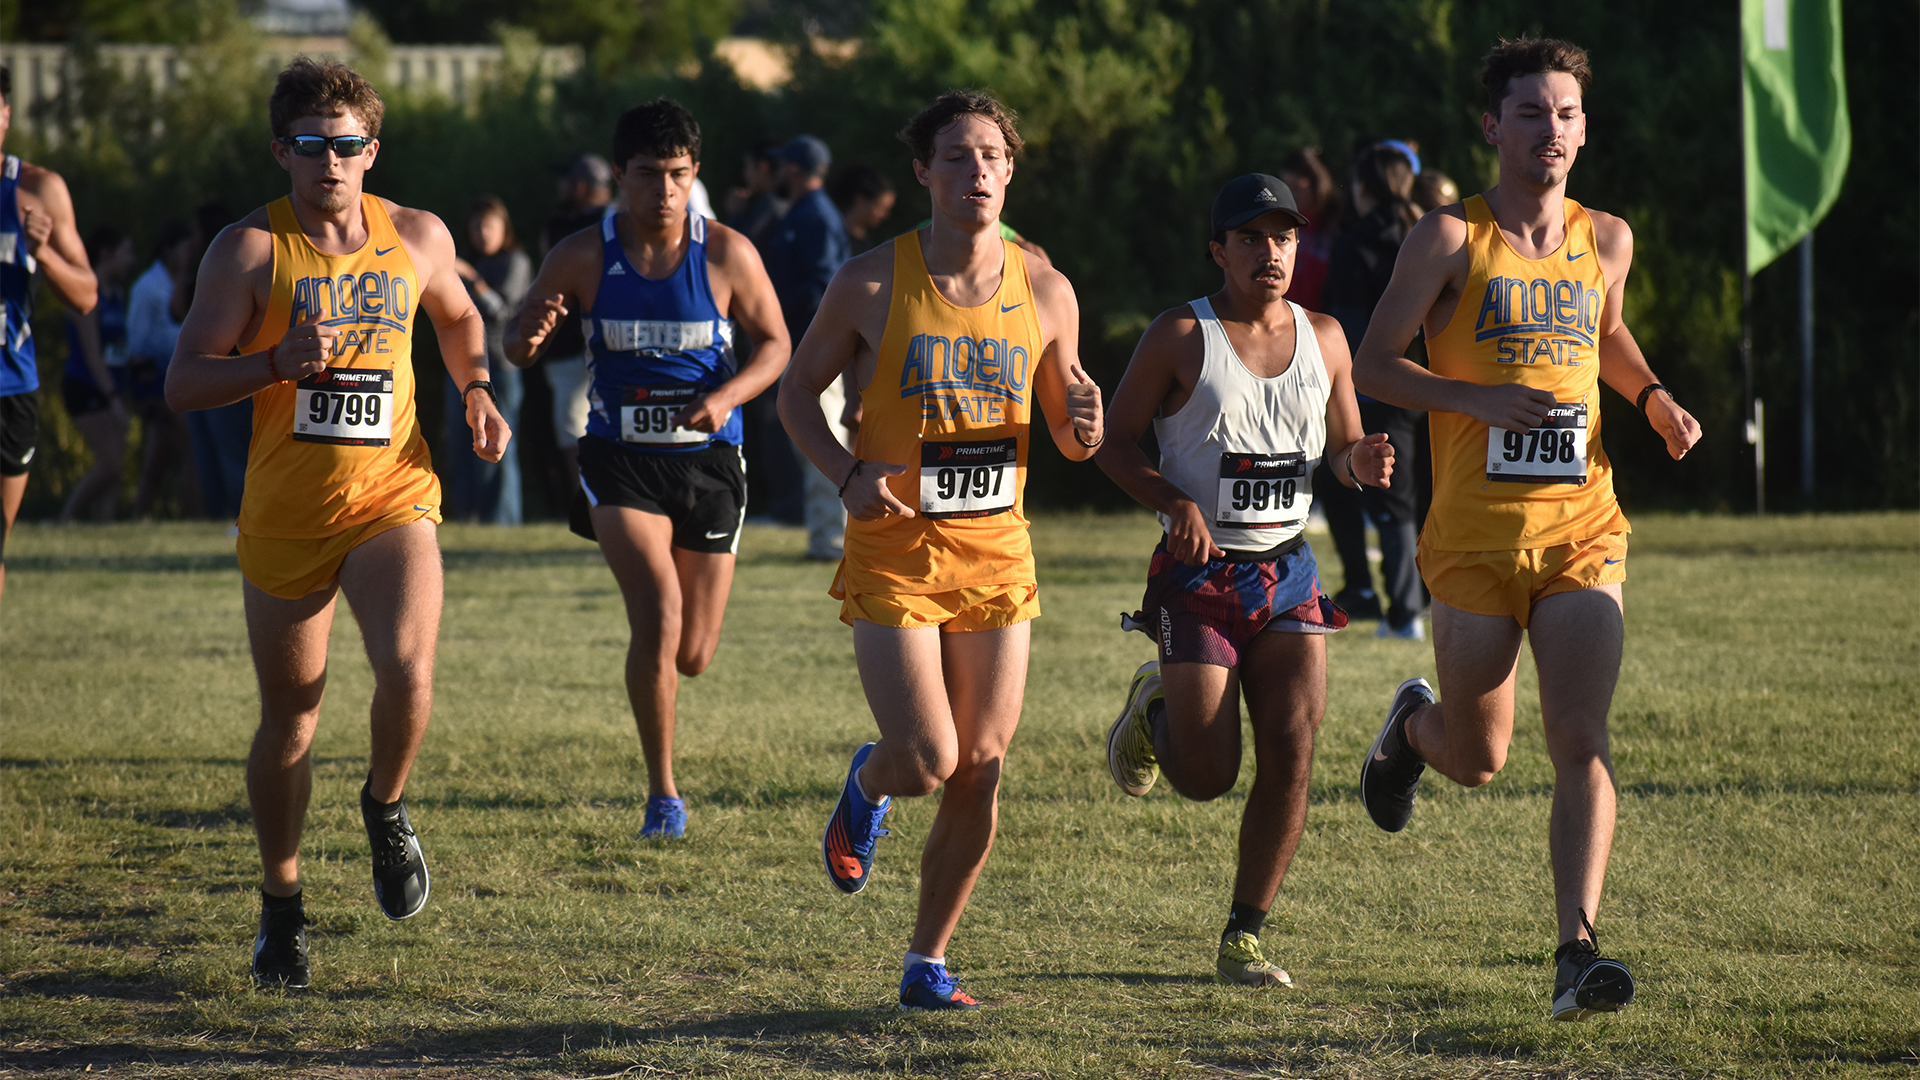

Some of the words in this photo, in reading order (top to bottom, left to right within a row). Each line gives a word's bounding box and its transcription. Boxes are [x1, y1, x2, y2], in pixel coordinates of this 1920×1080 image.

[289, 270, 410, 329] Angelo
[1475, 275, 1600, 334] Angelo
[332, 328, 391, 356] TATE
[601, 319, 715, 351] WESTERN
[900, 333, 1028, 391] Angelo
[1497, 337, 1582, 366] STATE
[332, 373, 382, 382] PRIMETIME
[650, 388, 695, 397] PRIMETIME
[308, 391, 381, 426] 9799
[633, 406, 689, 433] 997
[920, 393, 1005, 423] STATE
[955, 444, 1005, 455] PRIMETIME
[1503, 429, 1575, 464] 9798
[1253, 459, 1298, 468] PRIMETIME
[937, 465, 1004, 500] 9797
[1232, 478, 1296, 511] 9919
[1160, 605, 1172, 656] ADIZERO
